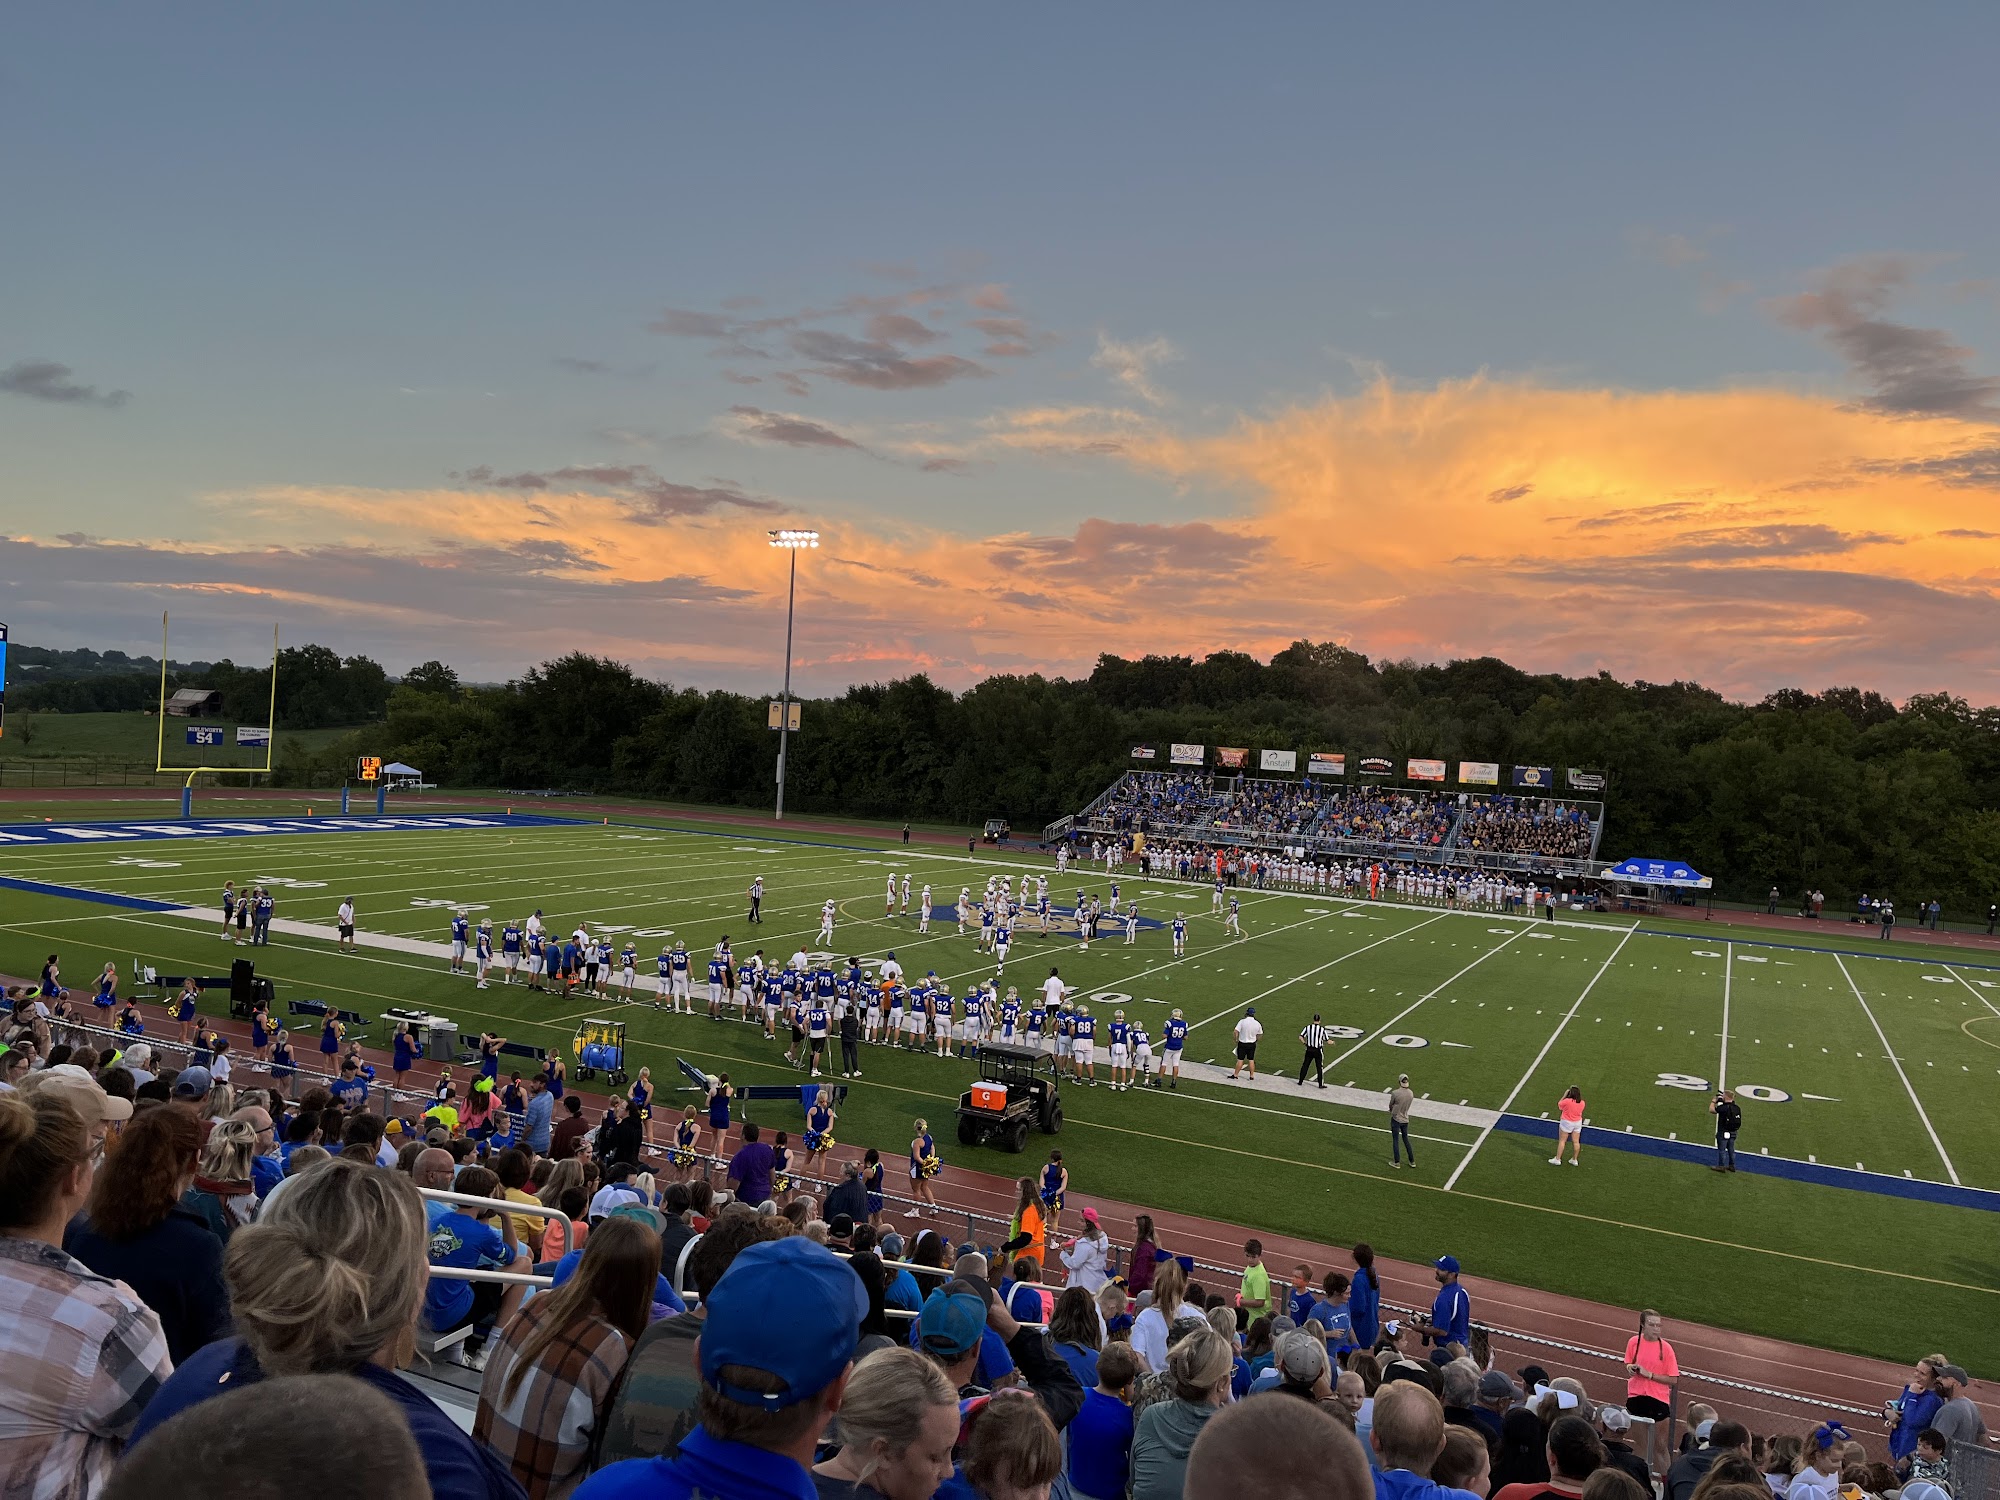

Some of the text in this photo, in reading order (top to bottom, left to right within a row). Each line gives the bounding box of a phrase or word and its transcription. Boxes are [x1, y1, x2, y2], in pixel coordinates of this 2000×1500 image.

[196, 732, 213, 744] 54
[1173, 745, 1201, 757] DSI
[1263, 759, 1291, 768] Anstaff
[1360, 757, 1393, 768] MAGNESS
[362, 766, 376, 780] 25
[261, 899, 272, 908] 33
[505, 932, 517, 942] 60
[770, 984, 782, 995] 78
[868, 994, 877, 1005] 14
[911, 995, 922, 1006] 72
[936, 1001, 949, 1011] 52
[966, 1003, 979, 1013] 39
[1004, 1009, 1016, 1020] 21
[1077, 1022, 1091, 1033] 68
[1172, 1027, 1185, 1038] 56
[1115, 1029, 1122, 1040] 7
[1135, 1032, 1147, 1042] 18
[982, 1091, 990, 1100] G
